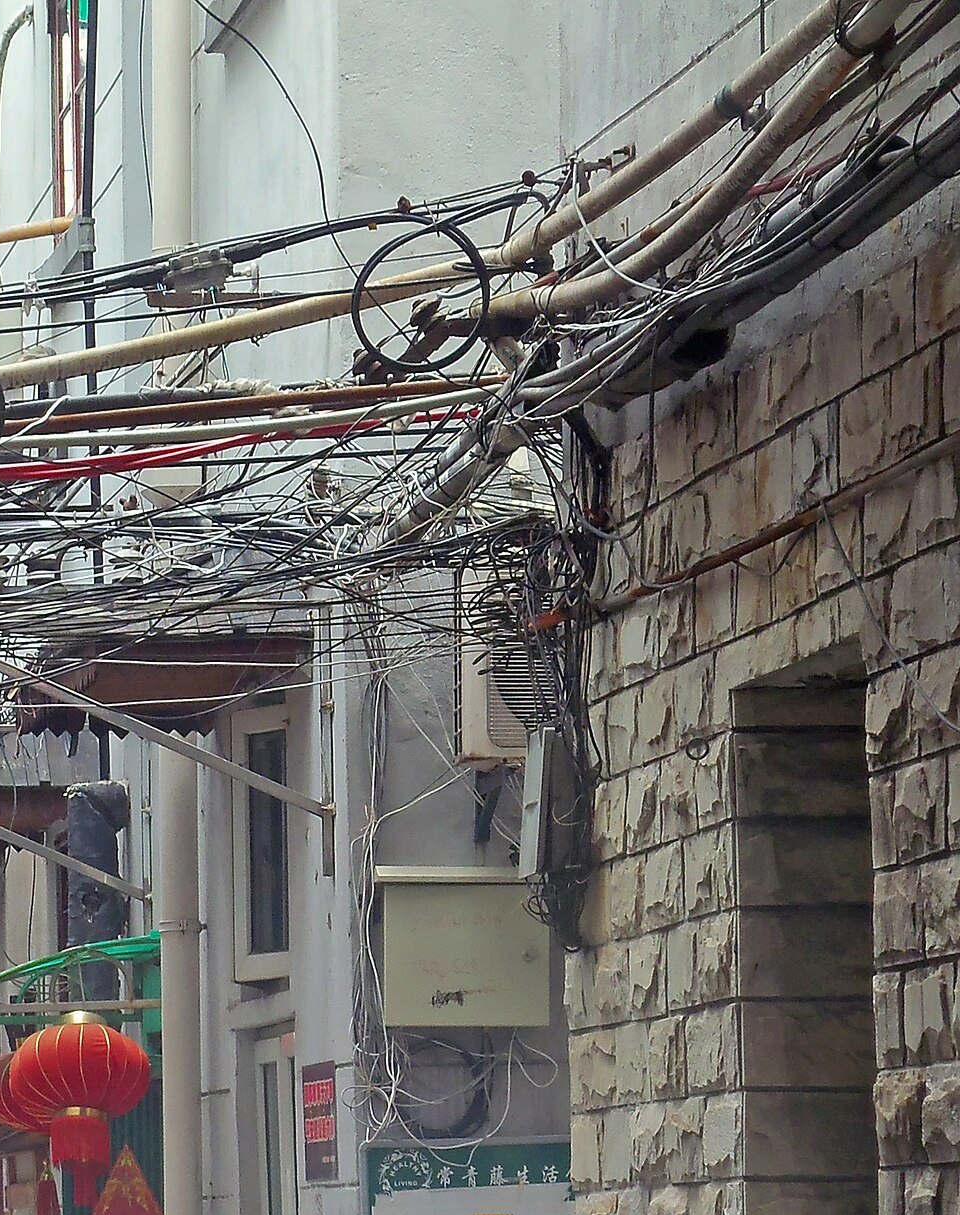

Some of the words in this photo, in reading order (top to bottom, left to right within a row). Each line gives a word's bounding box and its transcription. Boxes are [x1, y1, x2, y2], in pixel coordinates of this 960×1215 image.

[436, 1165, 571, 1189] 常青藤生活
